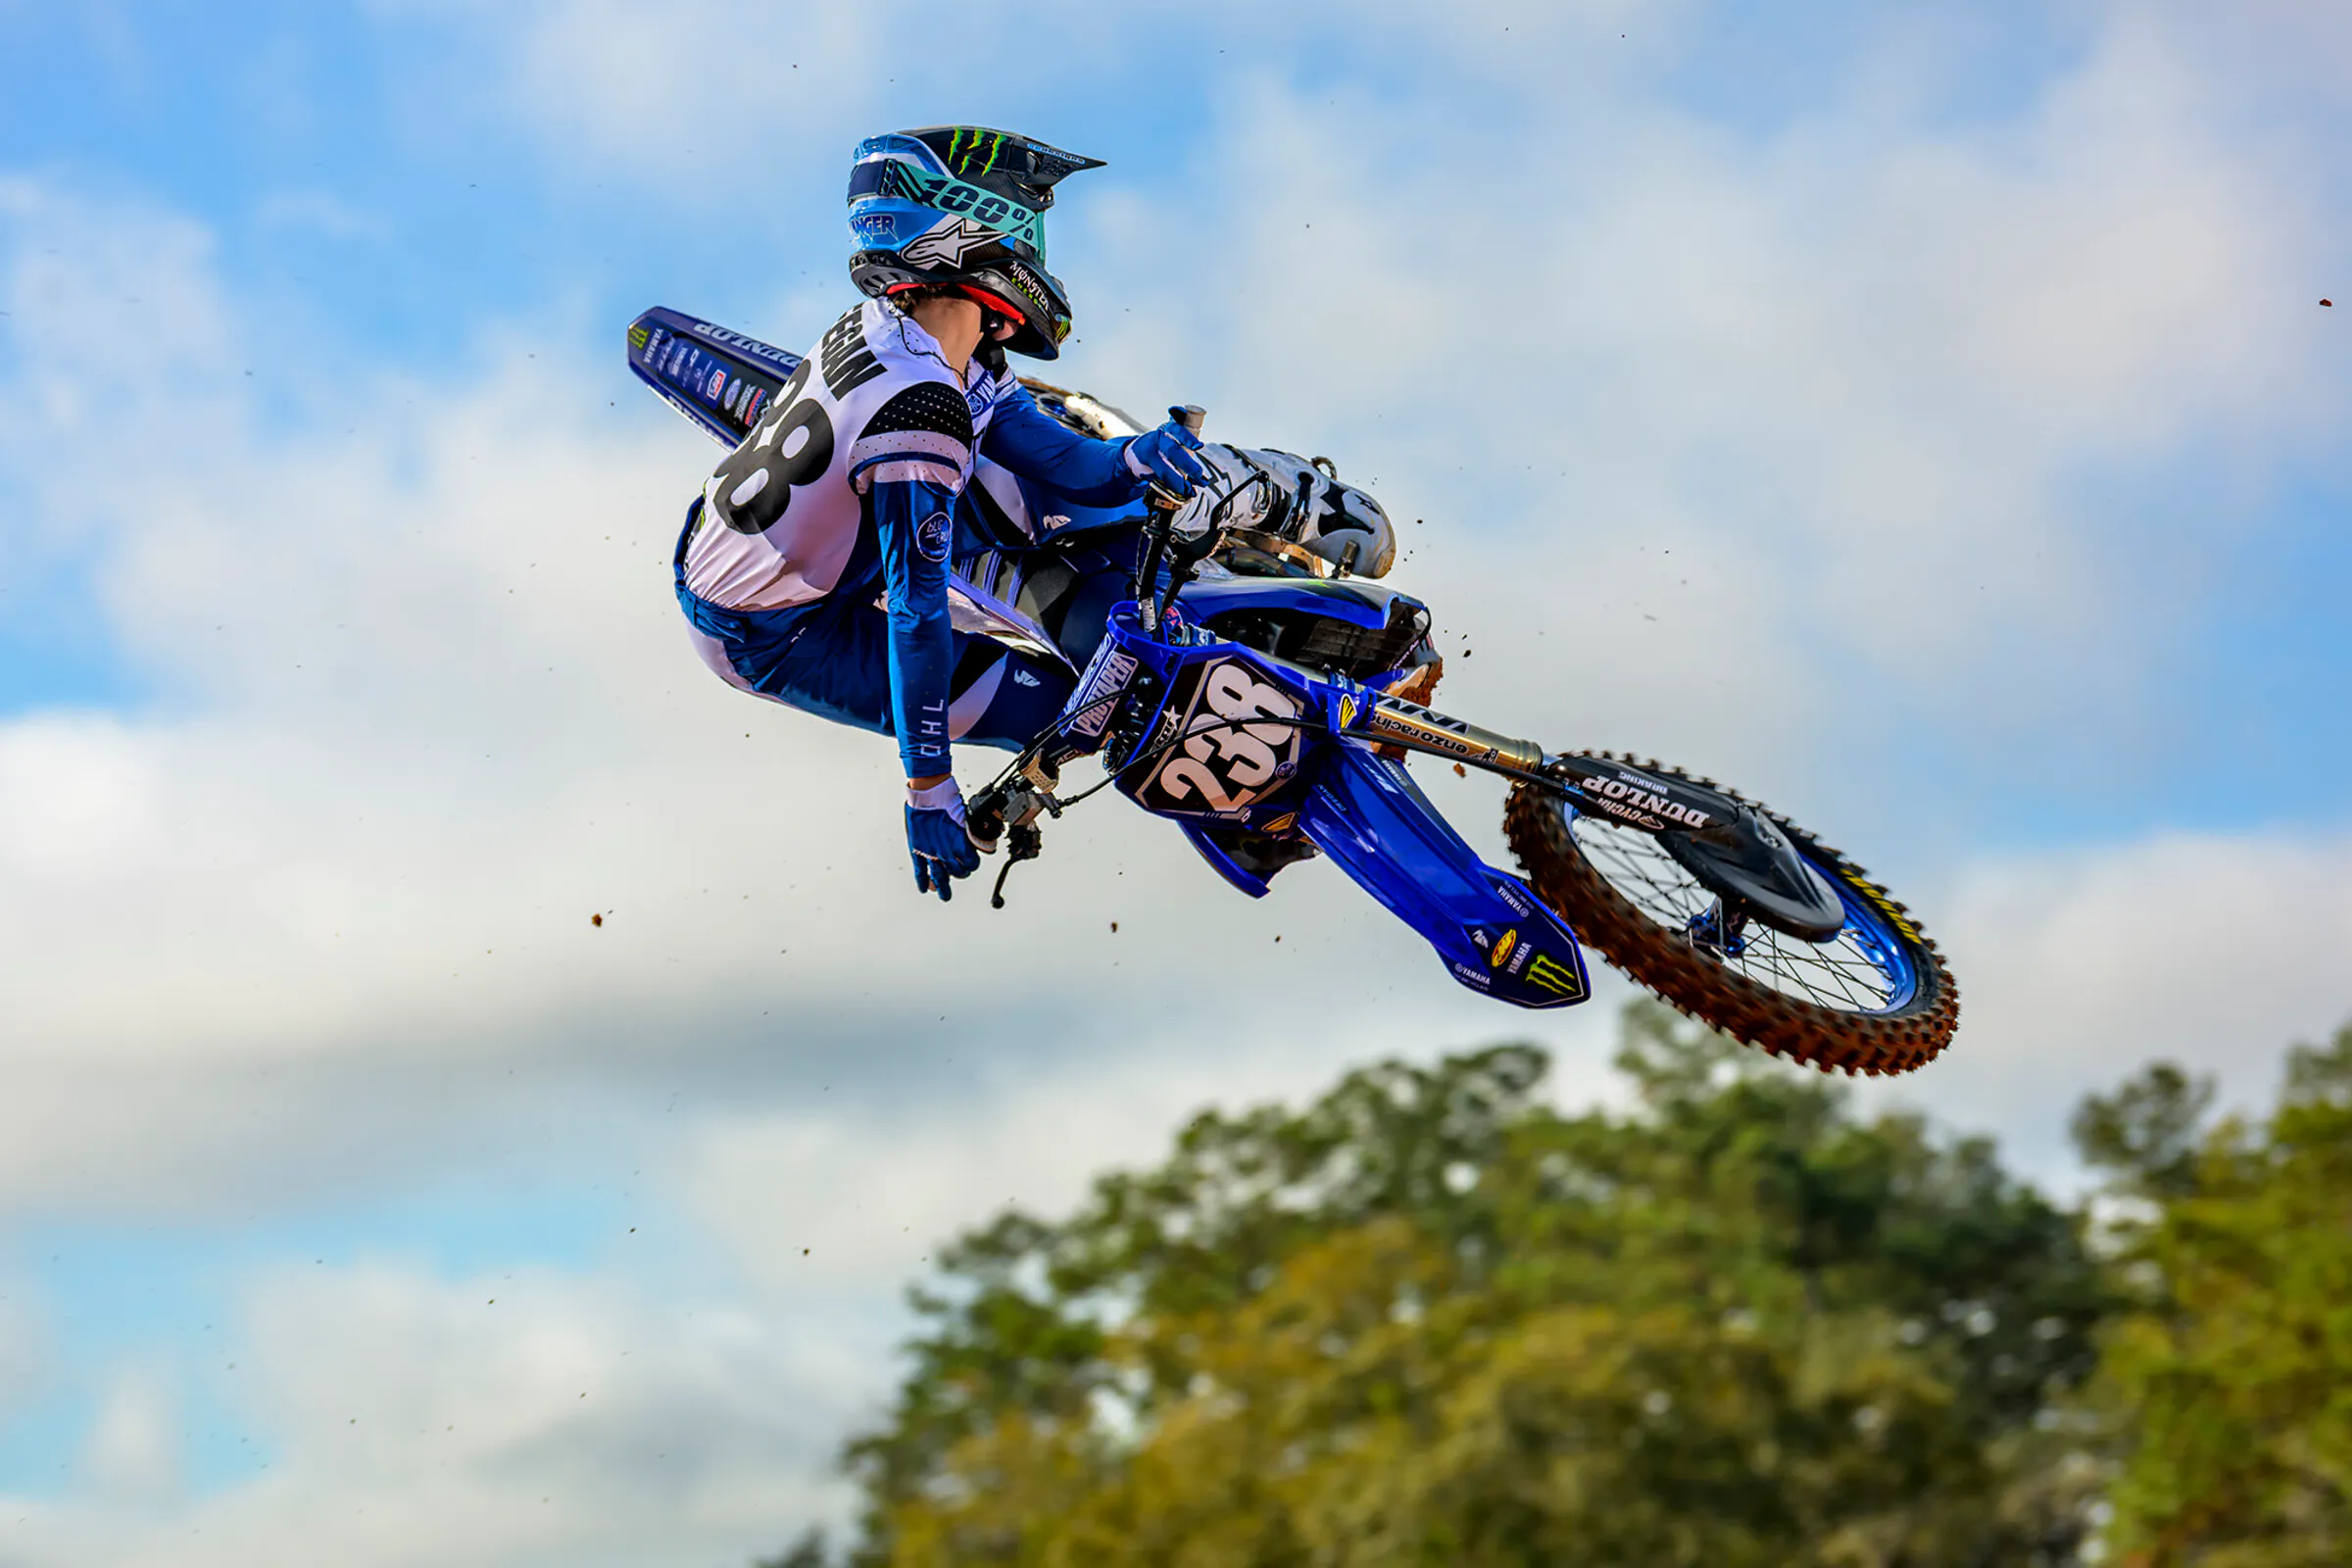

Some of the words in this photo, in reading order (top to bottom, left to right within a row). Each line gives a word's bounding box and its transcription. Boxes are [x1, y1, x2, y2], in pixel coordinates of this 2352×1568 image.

[921, 176, 1035, 241] 100%
[643, 327, 664, 364] YAMAHA
[694, 322, 804, 368] DUNLOP
[821, 302, 888, 402] EGAN
[1160, 663, 1297, 811] 238
[1420, 731, 1469, 754] enzo
[1582, 774, 1711, 829] DUNLOP
[1619, 771, 1668, 795] BRAKING
[1497, 885, 1522, 912] YAMAHA
[1461, 965, 1491, 985] YAMAHA
[1507, 942, 1532, 974] YAMAHA
